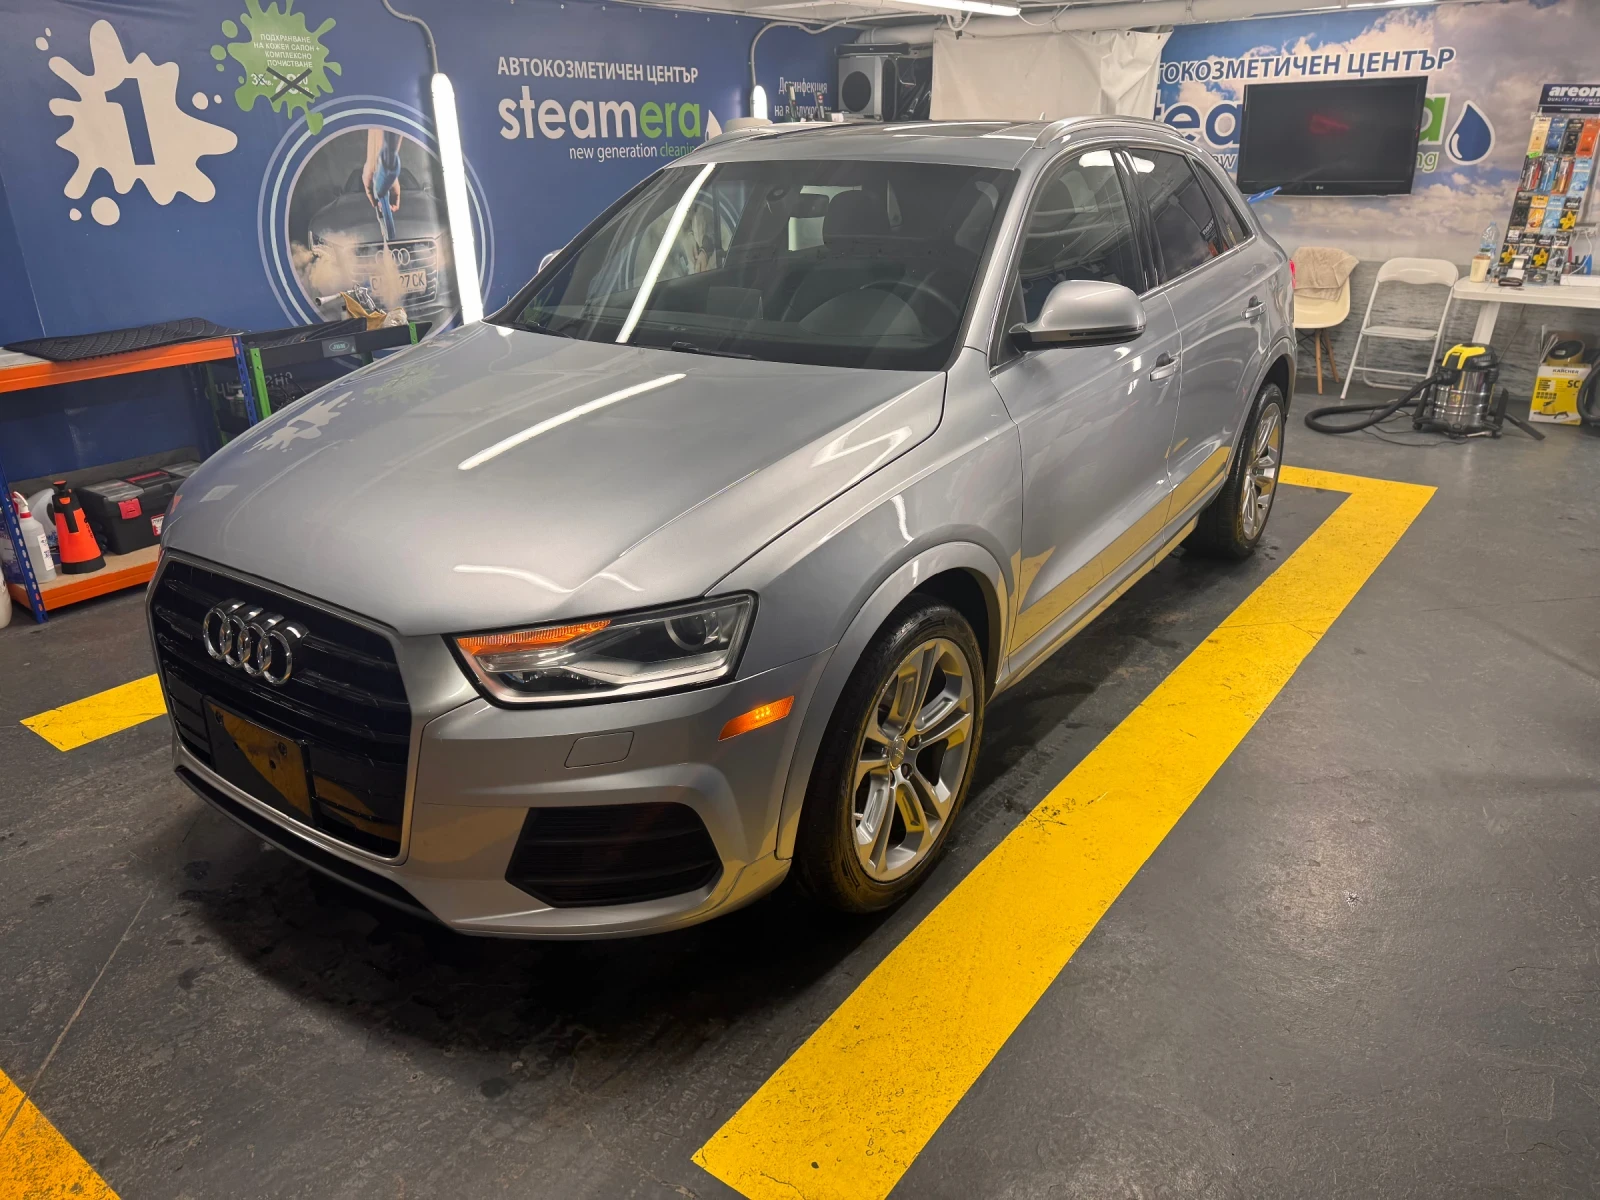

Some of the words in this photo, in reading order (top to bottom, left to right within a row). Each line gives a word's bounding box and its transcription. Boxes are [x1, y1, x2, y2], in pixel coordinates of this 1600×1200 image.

[260, 33, 311, 43] ПОДХРАНВАНЕ
[264, 51, 312, 60] КОМПЛЕКСНО
[291, 43, 315, 52] САЛОН
[267, 60, 313, 68] ПОЧИСТВАНЕ
[1348, 47, 1456, 77] ЦЕНТЪР
[498, 56, 643, 81] АВТОКОЗМЕТИЧЕН
[647, 65, 699, 85] ЦЕНТЪР
[498, 85, 700, 140] steamera
[774, 105, 784, 117] на
[105, 78, 155, 165] 1
[569, 147, 594, 159] new
[597, 142, 658, 162] generation
